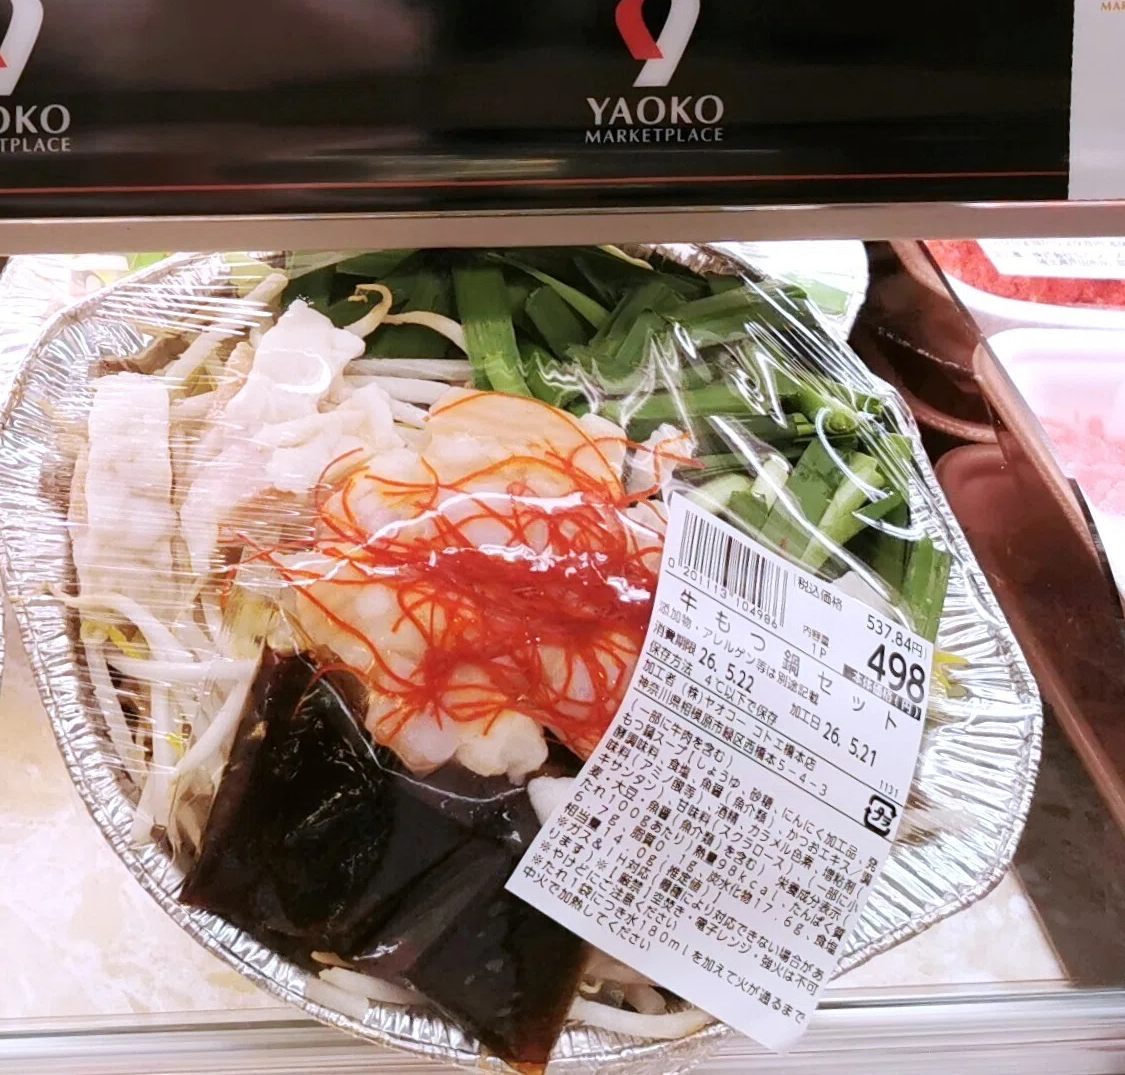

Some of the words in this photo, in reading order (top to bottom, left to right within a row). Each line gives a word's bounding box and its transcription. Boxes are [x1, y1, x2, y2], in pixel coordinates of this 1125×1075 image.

[586, 95, 724, 126] YAOKO
[585, 128, 724, 144] MARKETPLACE
[642, 660, 676, 687] 加工者
[648, 641, 694, 675] 保存方法
[863, 640, 932, 706] 498
[652, 621, 697, 654] 消費期限
[789, 703, 821, 730] 加工日
